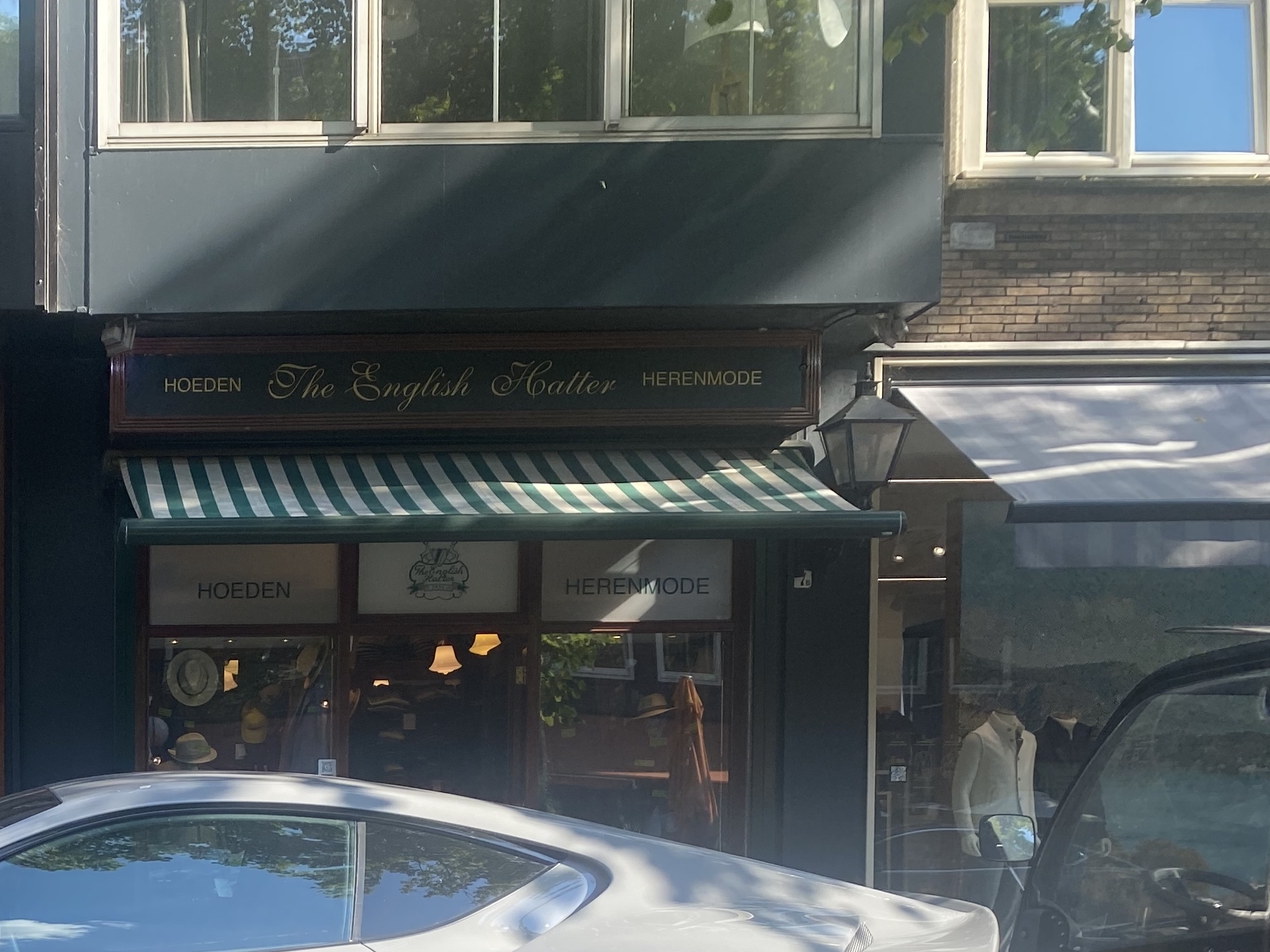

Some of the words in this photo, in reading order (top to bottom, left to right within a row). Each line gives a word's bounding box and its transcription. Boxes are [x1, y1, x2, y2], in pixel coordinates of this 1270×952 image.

[163, 377, 242, 393] HOEDEN
[267, 361, 336, 400] The
[344, 360, 473, 412] English
[490, 360, 618, 395] Hatter
[641, 370, 763, 387] HERENMODE
[197, 579, 291, 600] HOEDEN
[565, 576, 710, 597] HERENMODE
